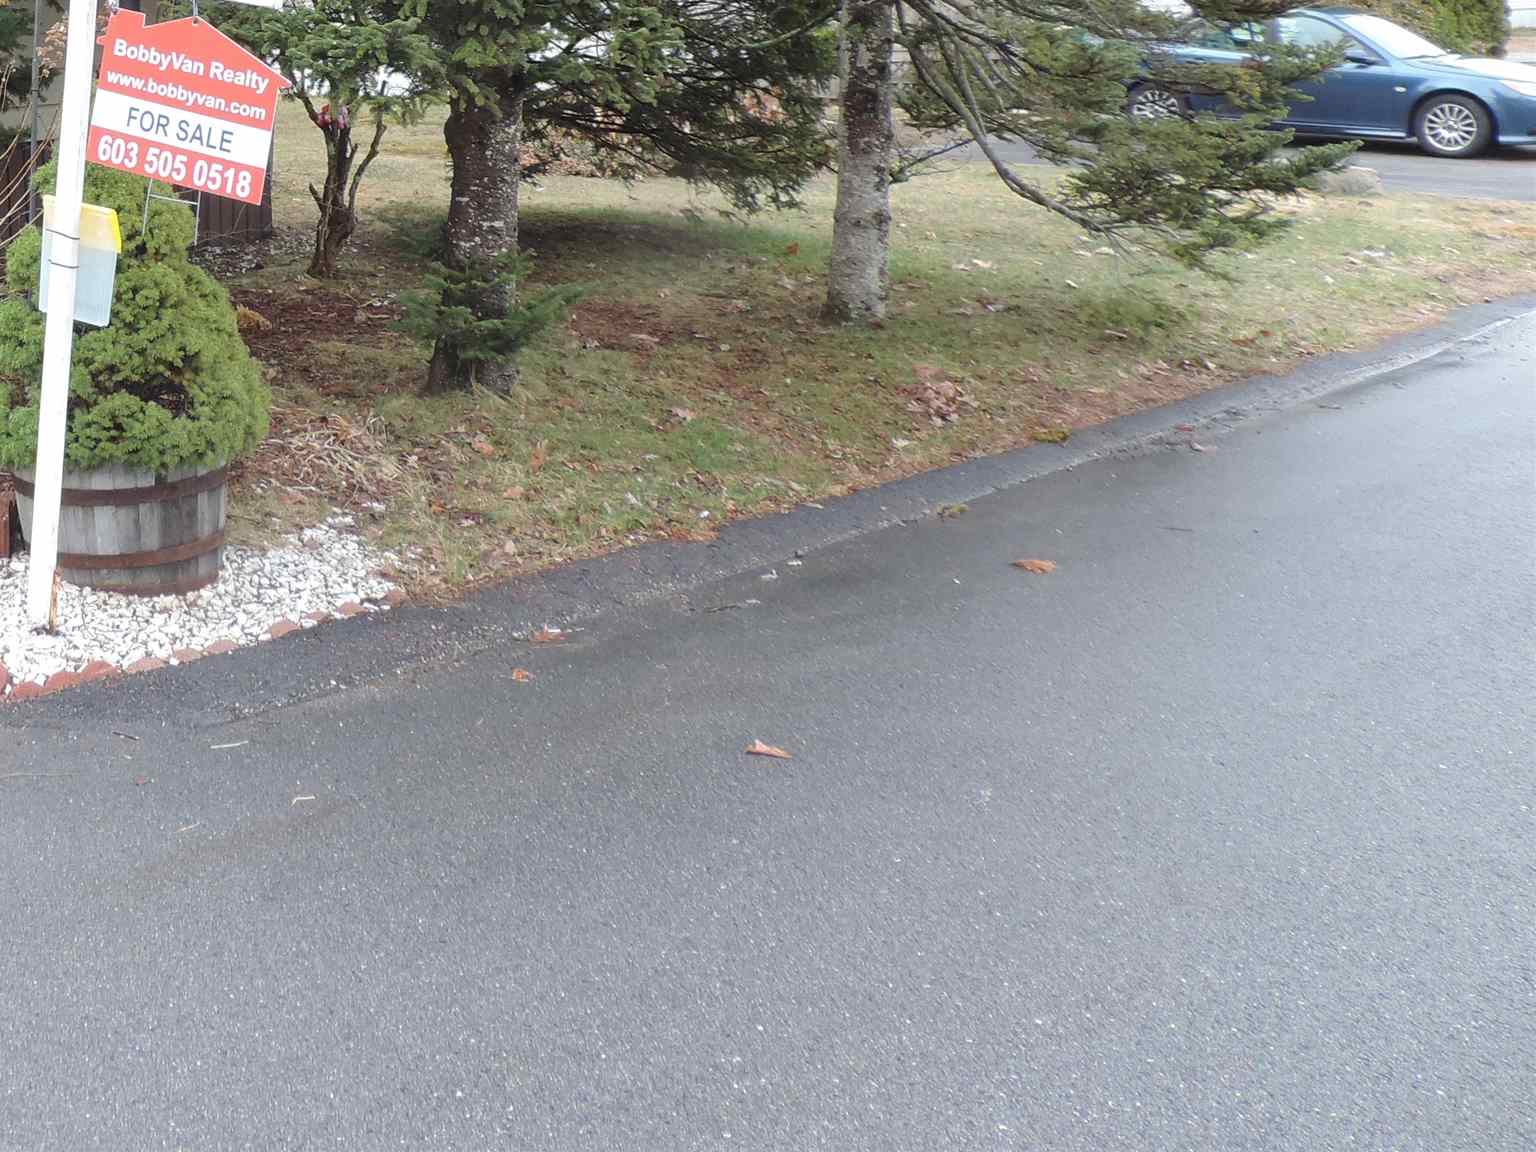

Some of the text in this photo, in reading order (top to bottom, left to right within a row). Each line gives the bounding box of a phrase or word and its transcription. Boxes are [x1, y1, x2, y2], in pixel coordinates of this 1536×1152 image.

[113, 38, 270, 94] BobbyVan Realty
[106, 70, 267, 120] www.bobbyvan.com
[126, 107, 234, 153] FOR SALE
[97, 134, 252, 198] 603 505 0518
